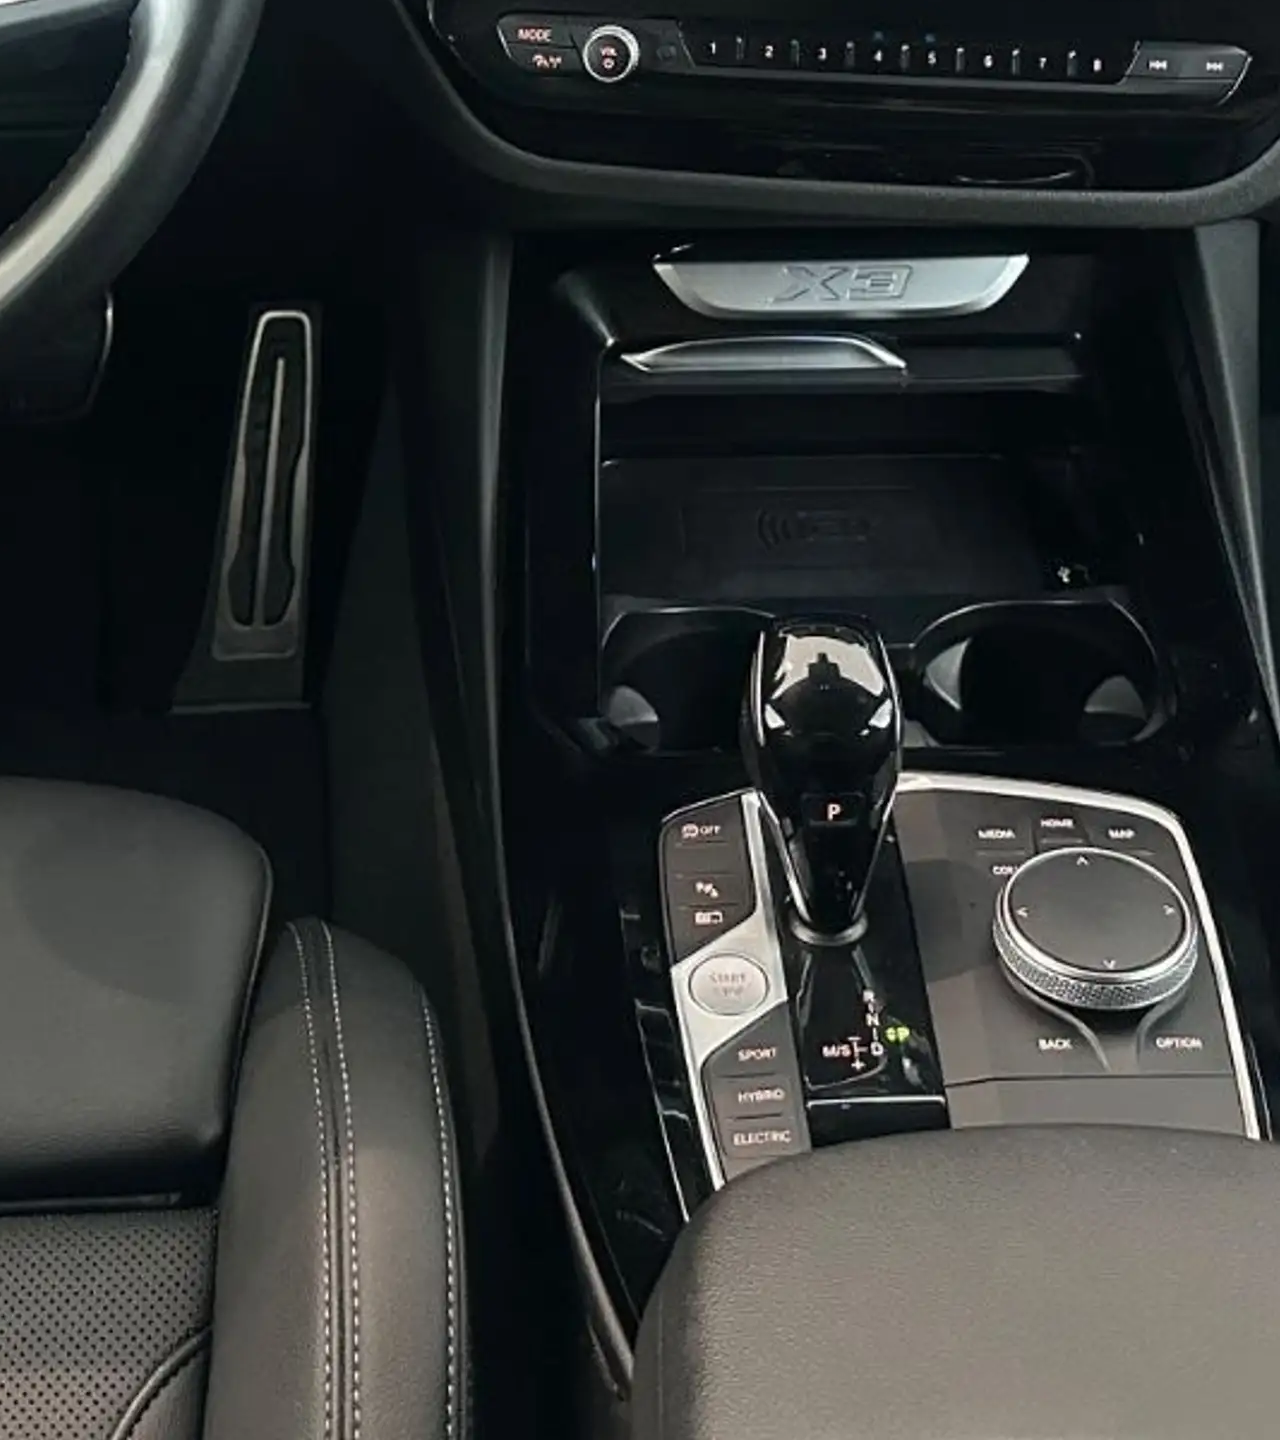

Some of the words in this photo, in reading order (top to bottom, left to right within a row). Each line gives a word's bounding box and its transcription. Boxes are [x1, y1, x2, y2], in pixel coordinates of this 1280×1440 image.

[771, 264, 914, 305] X3
[827, 802, 842, 821] P
[864, 1012, 880, 1027] N
[1038, 1037, 1072, 1051] BACK
[737, 1046, 776, 1061] SPORT
[733, 1129, 791, 1146] ELECTRIC
